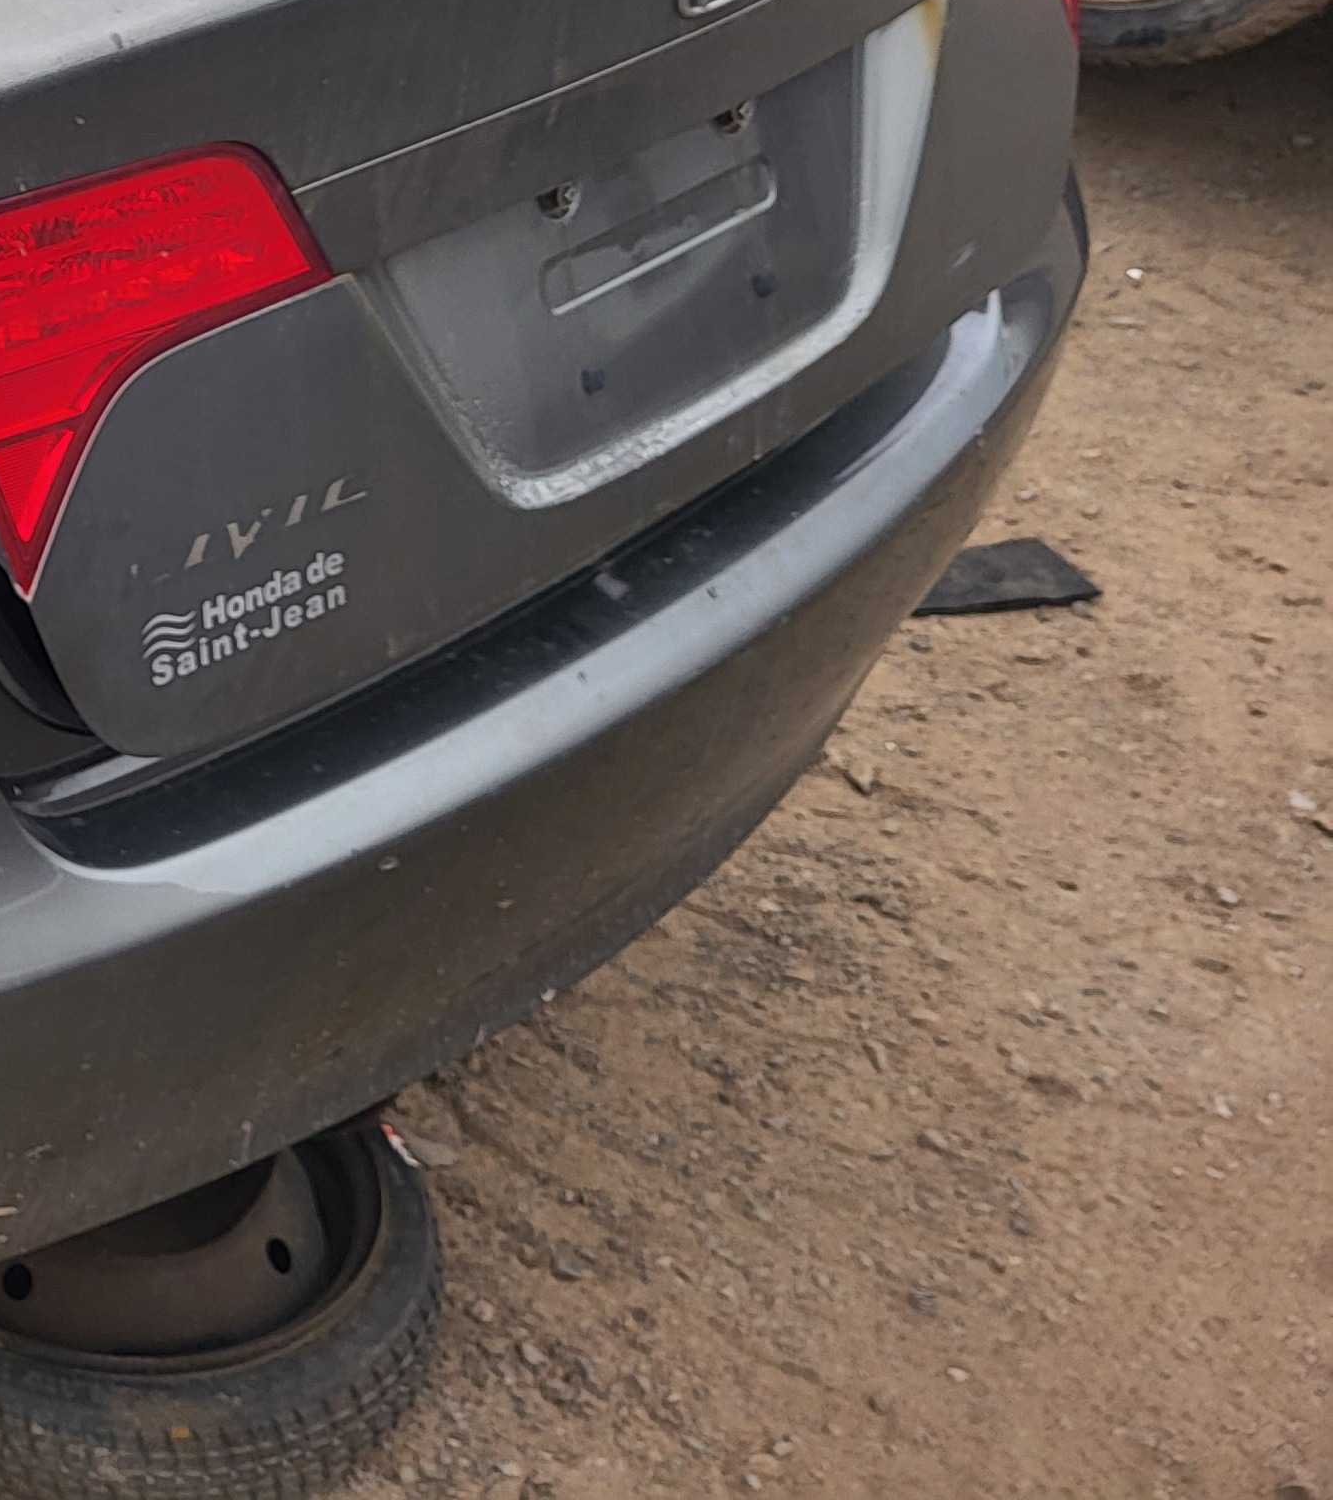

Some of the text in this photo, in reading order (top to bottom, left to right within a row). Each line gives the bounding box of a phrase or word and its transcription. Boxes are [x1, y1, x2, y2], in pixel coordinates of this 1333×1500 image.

[149, 583, 348, 688] Saint-Jean
[201, 550, 346, 631] Honda de
